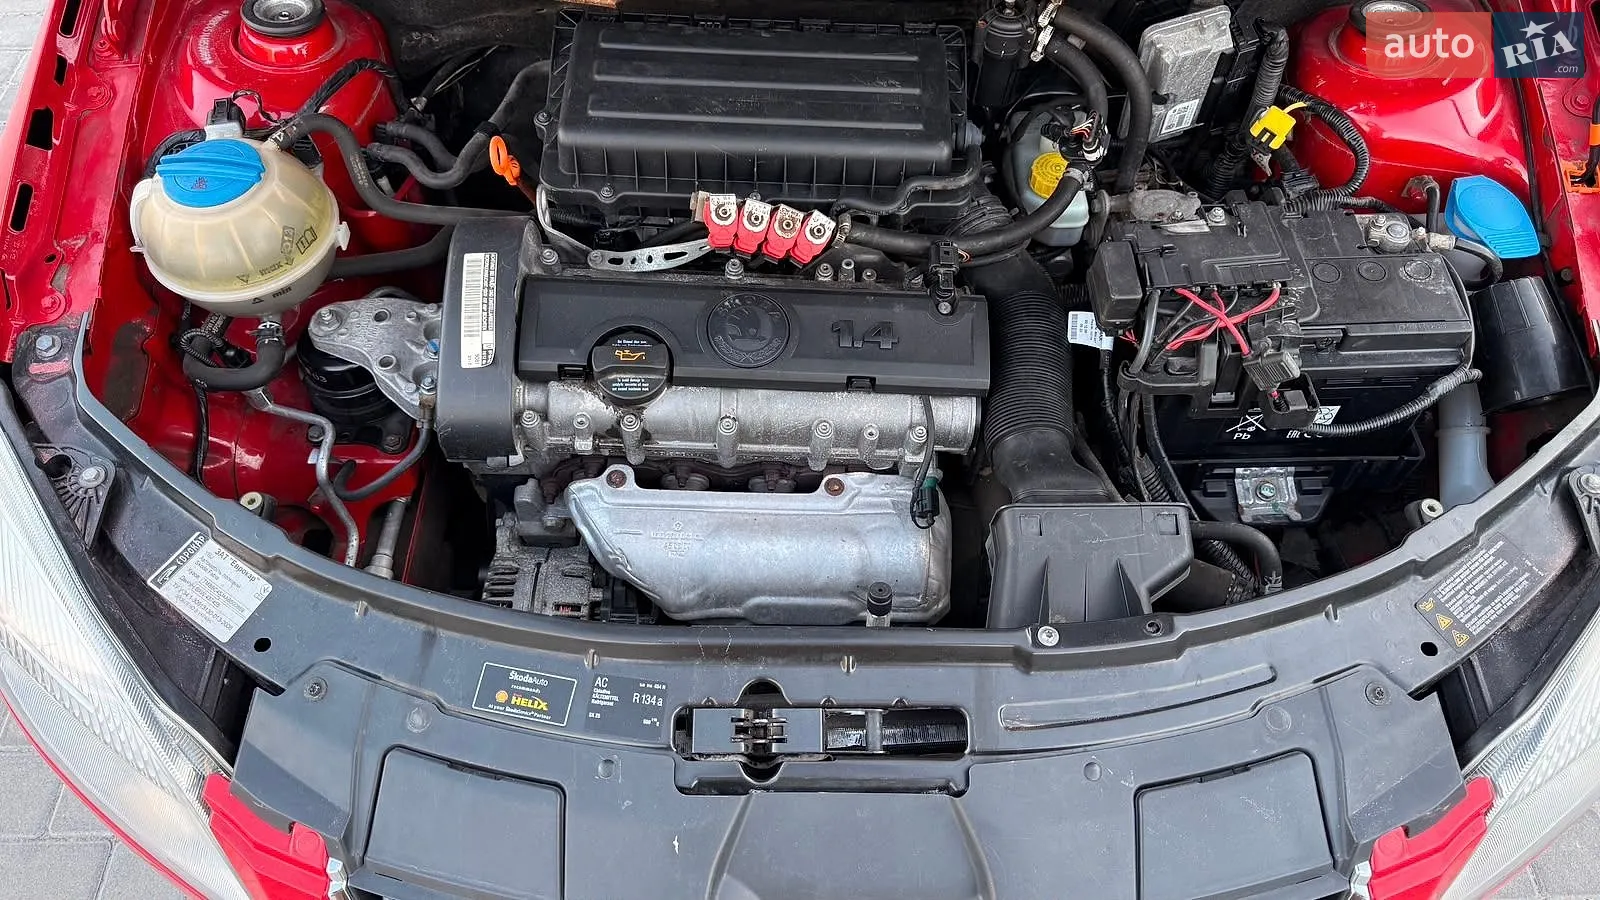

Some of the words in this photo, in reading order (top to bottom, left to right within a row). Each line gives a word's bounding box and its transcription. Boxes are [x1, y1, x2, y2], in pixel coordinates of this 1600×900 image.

[272, 287, 292, 298] min
[832, 320, 899, 349] 1.4
[215, 548, 229, 561] ЗАТ
[594, 676, 609, 688] AC
[511, 695, 548, 711] HELIX
